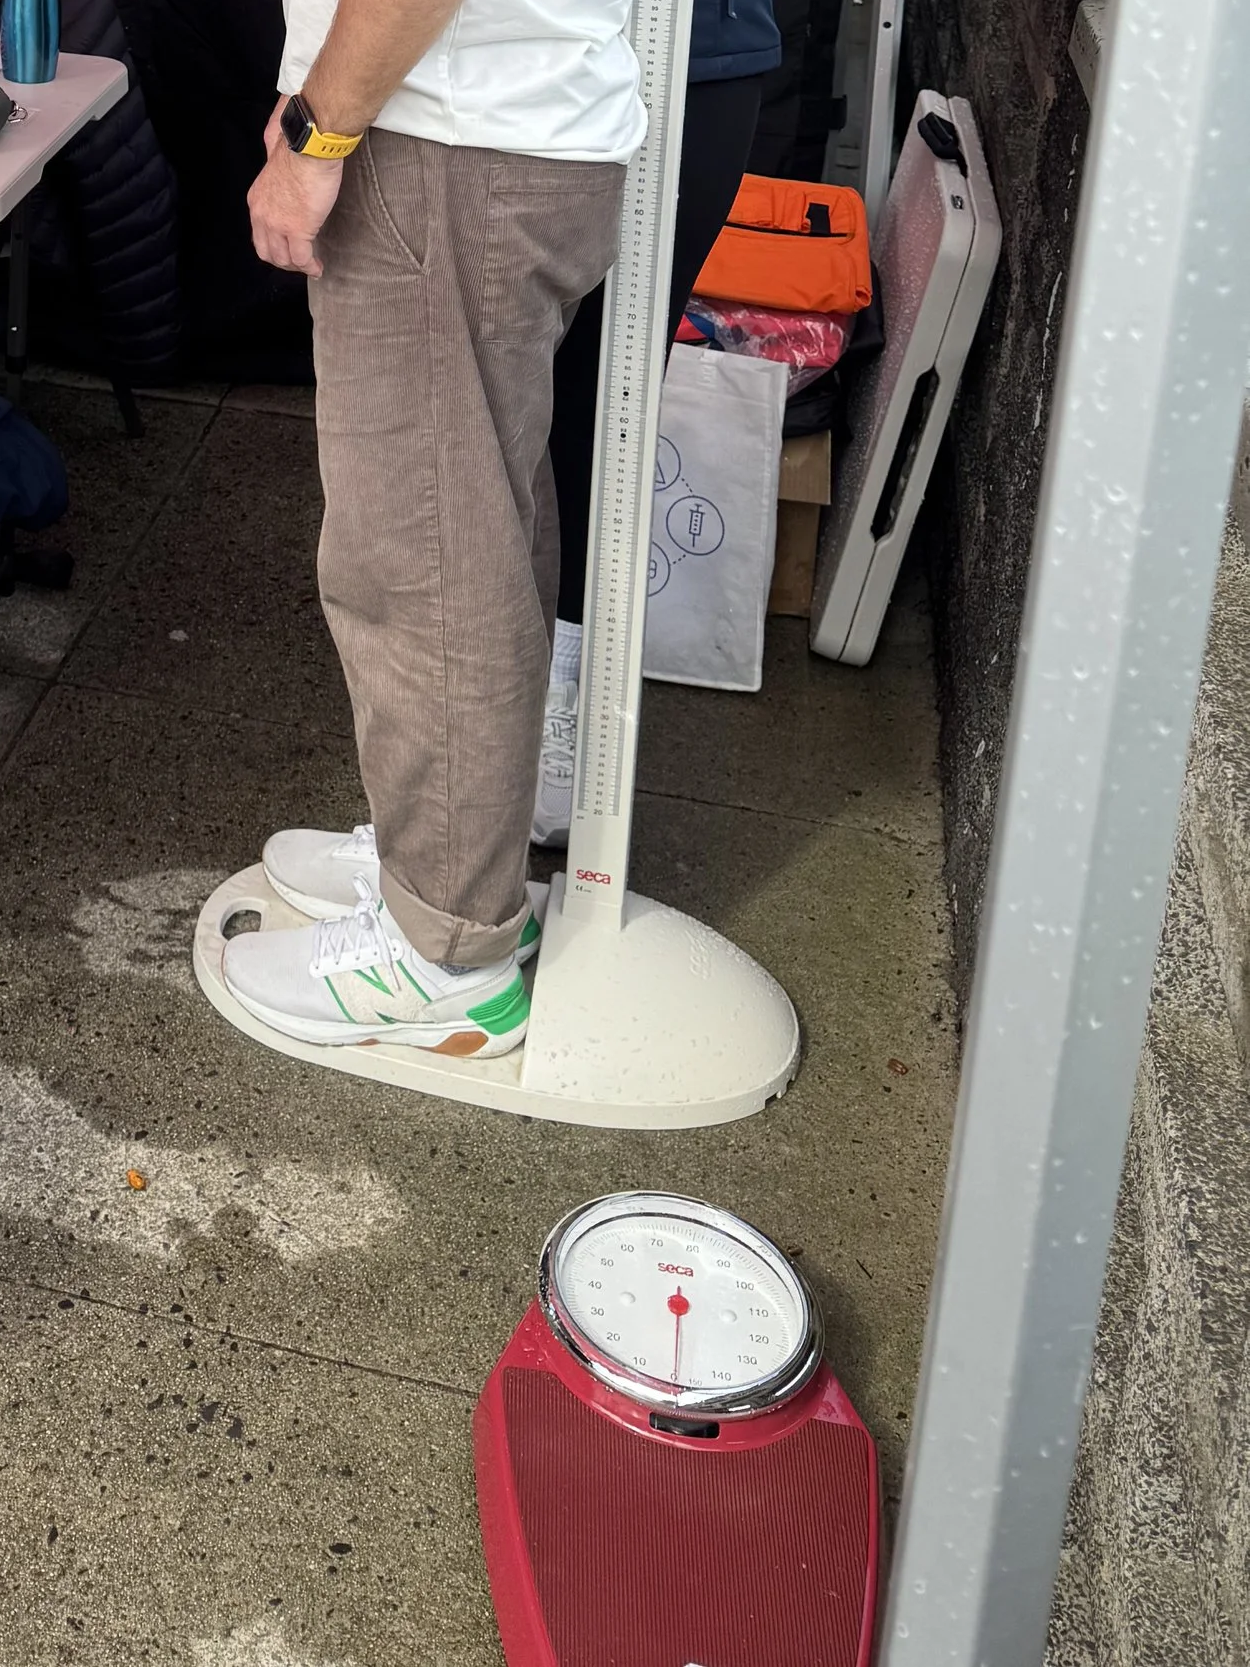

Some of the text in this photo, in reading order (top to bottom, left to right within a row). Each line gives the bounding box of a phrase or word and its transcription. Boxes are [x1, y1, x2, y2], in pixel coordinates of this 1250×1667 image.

[626, 312, 636, 320] 70
[619, 416, 629, 424] 60
[576, 869, 611, 885] seca
[620, 1243, 634, 1253] 60
[650, 1238, 664, 1248] 70
[685, 1244, 700, 1254] 80
[600, 1257, 614, 1268] 50
[657, 1261, 694, 1278] seca
[588, 1280, 602, 1290] 40
[735, 1280, 755, 1291] 100
[590, 1307, 605, 1317] 30
[749, 1308, 769, 1319] 110
[606, 1332, 621, 1342] 20
[749, 1334, 770, 1345] 120
[633, 1356, 647, 1366] 10
[737, 1354, 758, 1366] 130
[711, 1370, 732, 1382] 140
[688, 1378, 703, 1386] 150
